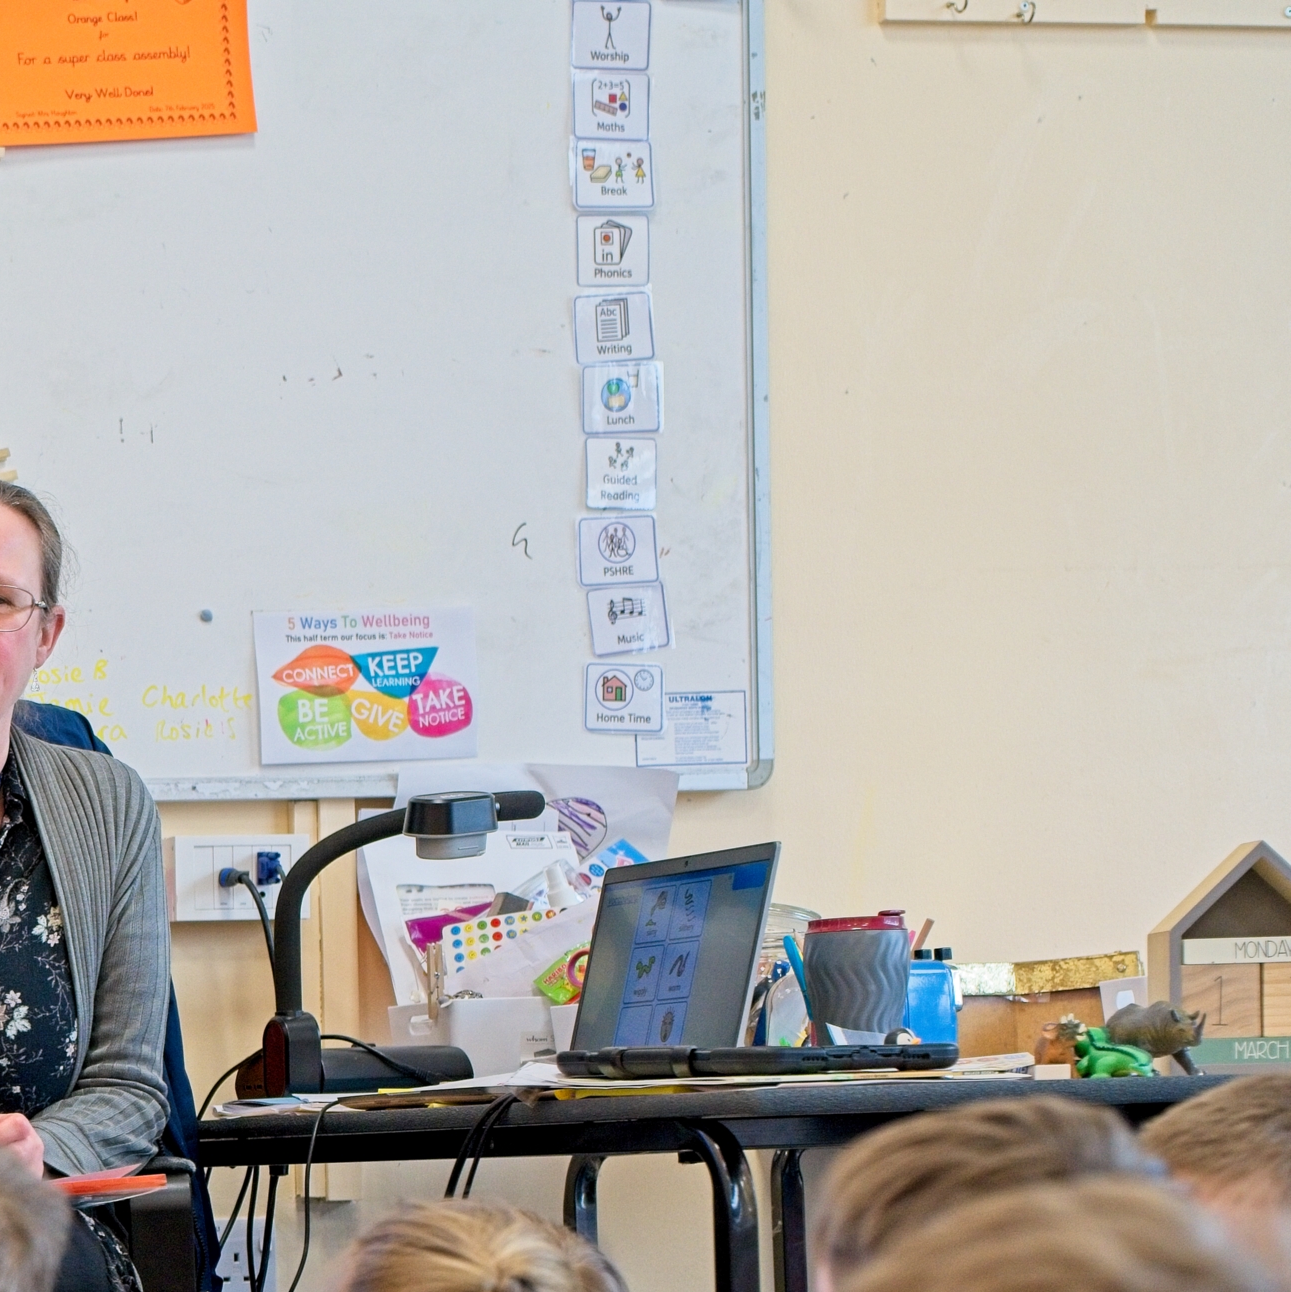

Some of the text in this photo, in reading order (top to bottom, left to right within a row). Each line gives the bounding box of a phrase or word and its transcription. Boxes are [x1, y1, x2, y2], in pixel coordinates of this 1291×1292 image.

[67, 11, 138, 26] Orange Class!
[17, 46, 191, 68] For a super class assembly!
[590, 51, 630, 64] Worship
[64, 86, 154, 103] Very Well Done!
[597, 121, 625, 133] Maths
[600, 185, 628, 196] Break
[602, 249, 614, 262] in
[594, 268, 633, 279] Phonics
[600, 307, 617, 317] Abc
[597, 343, 632, 356] Writing
[606, 414, 635, 426] Lunch
[603, 474, 638, 485] Guided
[600, 490, 640, 503] Reading
[603, 566, 634, 577] PSHRE
[288, 614, 431, 632] 5 Ways To Wellbeing
[285, 630, 434, 643] This half term our focus is: Take Notice
[617, 632, 645, 645] Music
[93, 658, 108, 680] B
[368, 652, 423, 677] KEEP
[282, 663, 354, 683] CONNECT
[371, 676, 421, 688] LEARNING
[141, 684, 254, 714] Charlotte
[412, 686, 466, 714] TAKE
[297, 699, 329, 724] BE
[351, 698, 404, 733] GIVE
[419, 707, 465, 729] NOTICE
[596, 713, 652, 725] Home Time
[155, 718, 215, 743] Rosie
[294, 722, 347, 742] ACTIVE
[543, 963, 567, 985] HARIBO
[1211, 975, 1229, 1026] 1
[1234, 1040, 1291, 1060] MARCH
